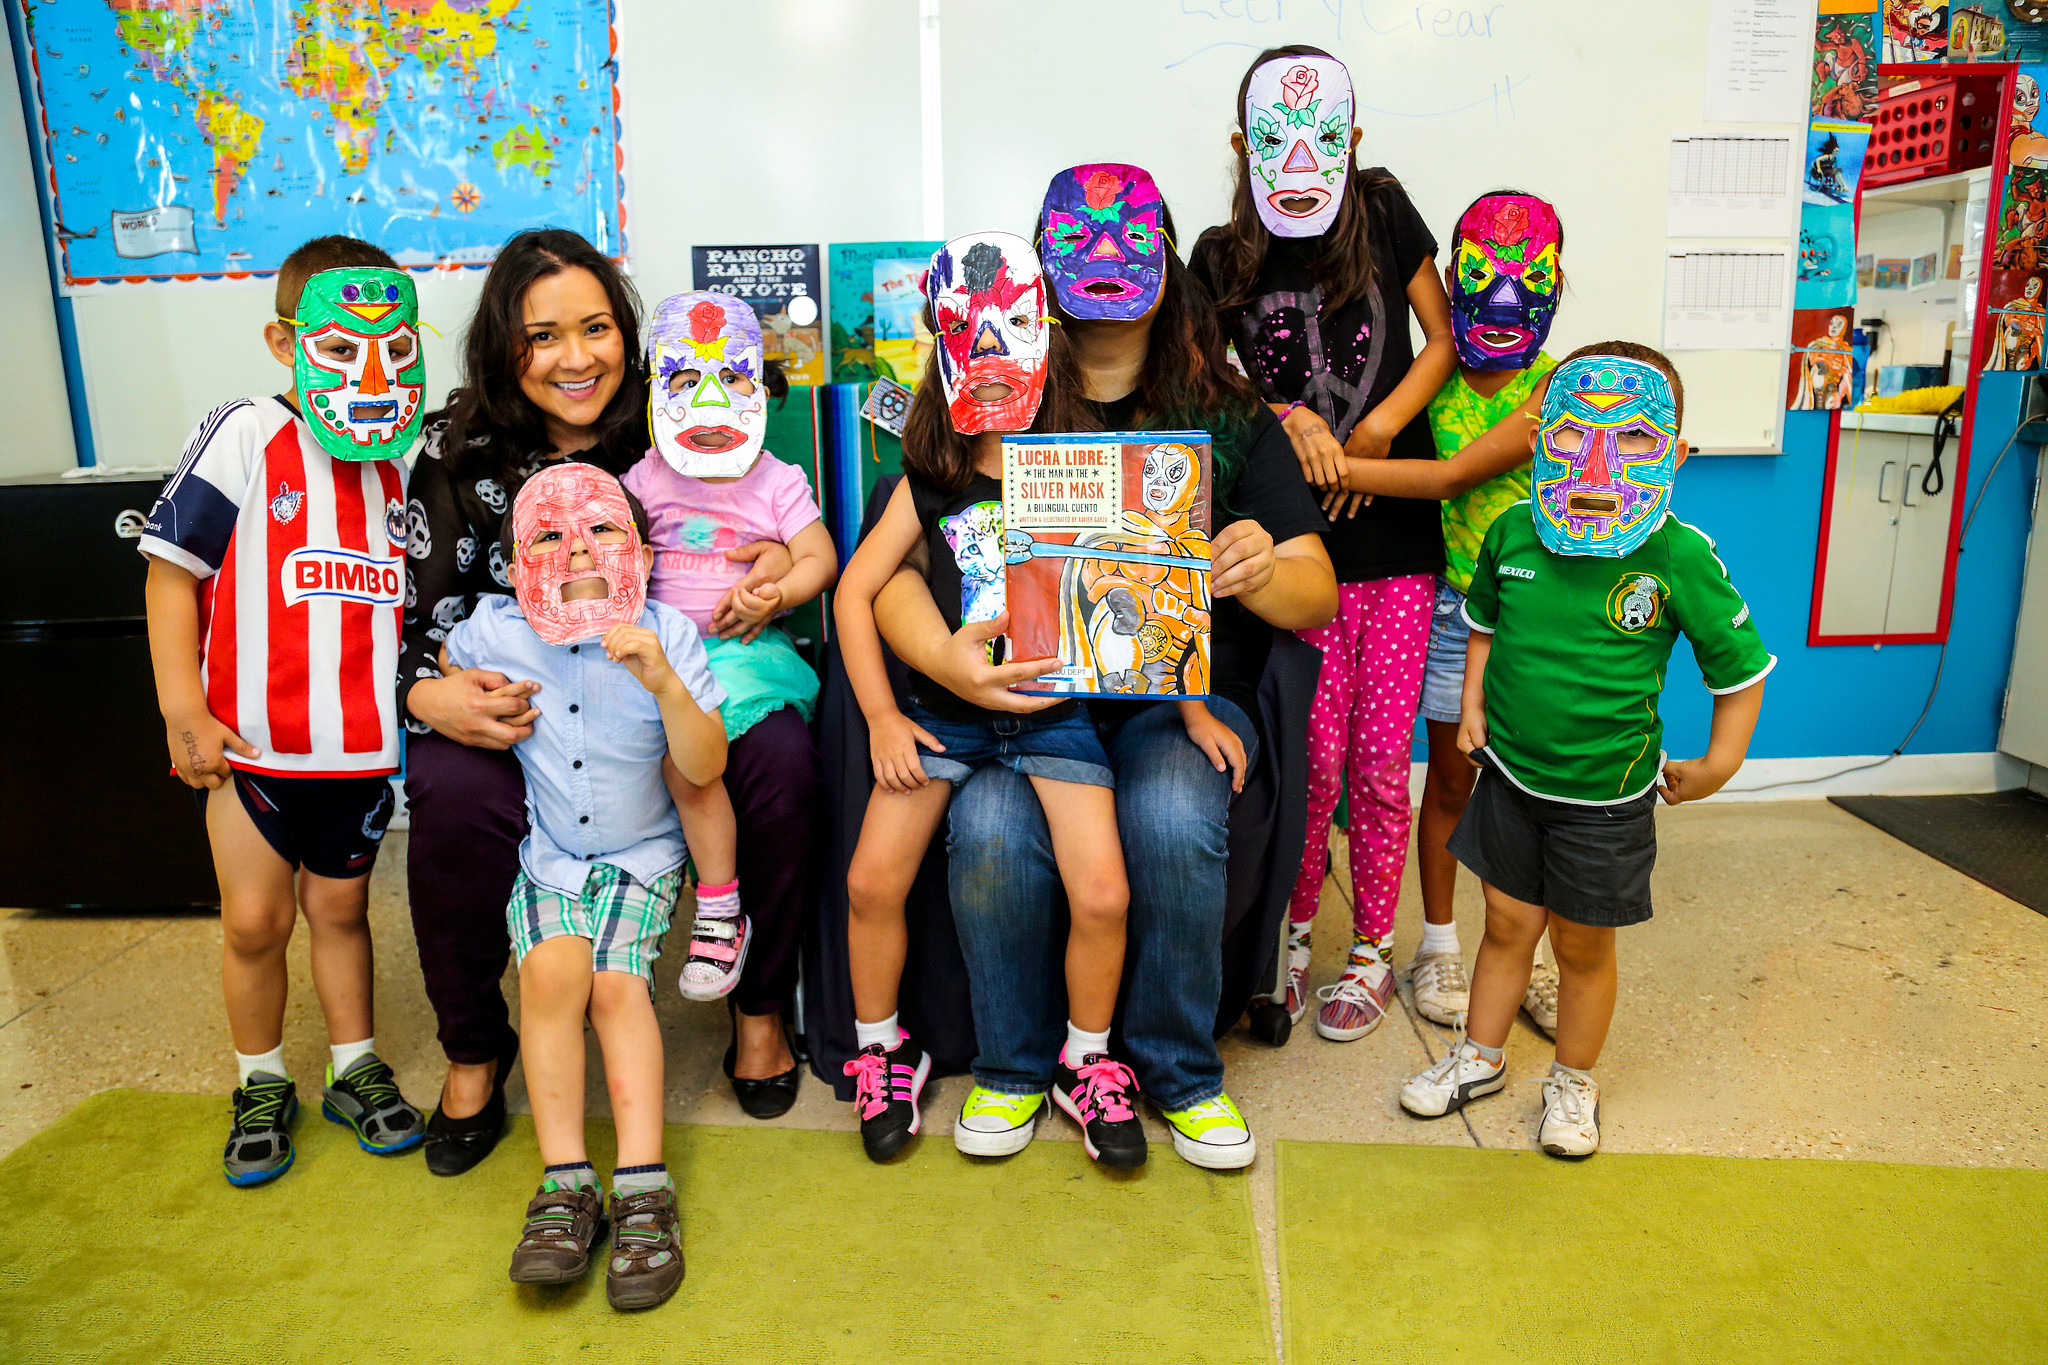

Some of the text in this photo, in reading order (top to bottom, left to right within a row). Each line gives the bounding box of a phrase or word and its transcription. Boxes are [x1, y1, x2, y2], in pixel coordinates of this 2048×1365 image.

[120, 218, 158, 230] WORLD
[706, 249, 806, 263] PANCHO
[706, 262, 806, 277] RABBIT
[732, 276, 756, 284] AND
[882, 279, 904, 292] The
[708, 283, 807, 297] COYOTE
[1017, 450, 1108, 466] LUCHA LIBRE:
[1033, 469, 1089, 478] THE MAN IN THE
[1020, 482, 1105, 499] SILVER MASK
[665, 508, 686, 521] OLD
[1026, 503, 1098, 513] A BILINGUAL CUENTO
[661, 550, 735, 574] SHOPPE
[295, 560, 399, 596] BIMBO
[1498, 564, 1536, 580] MEXICO
